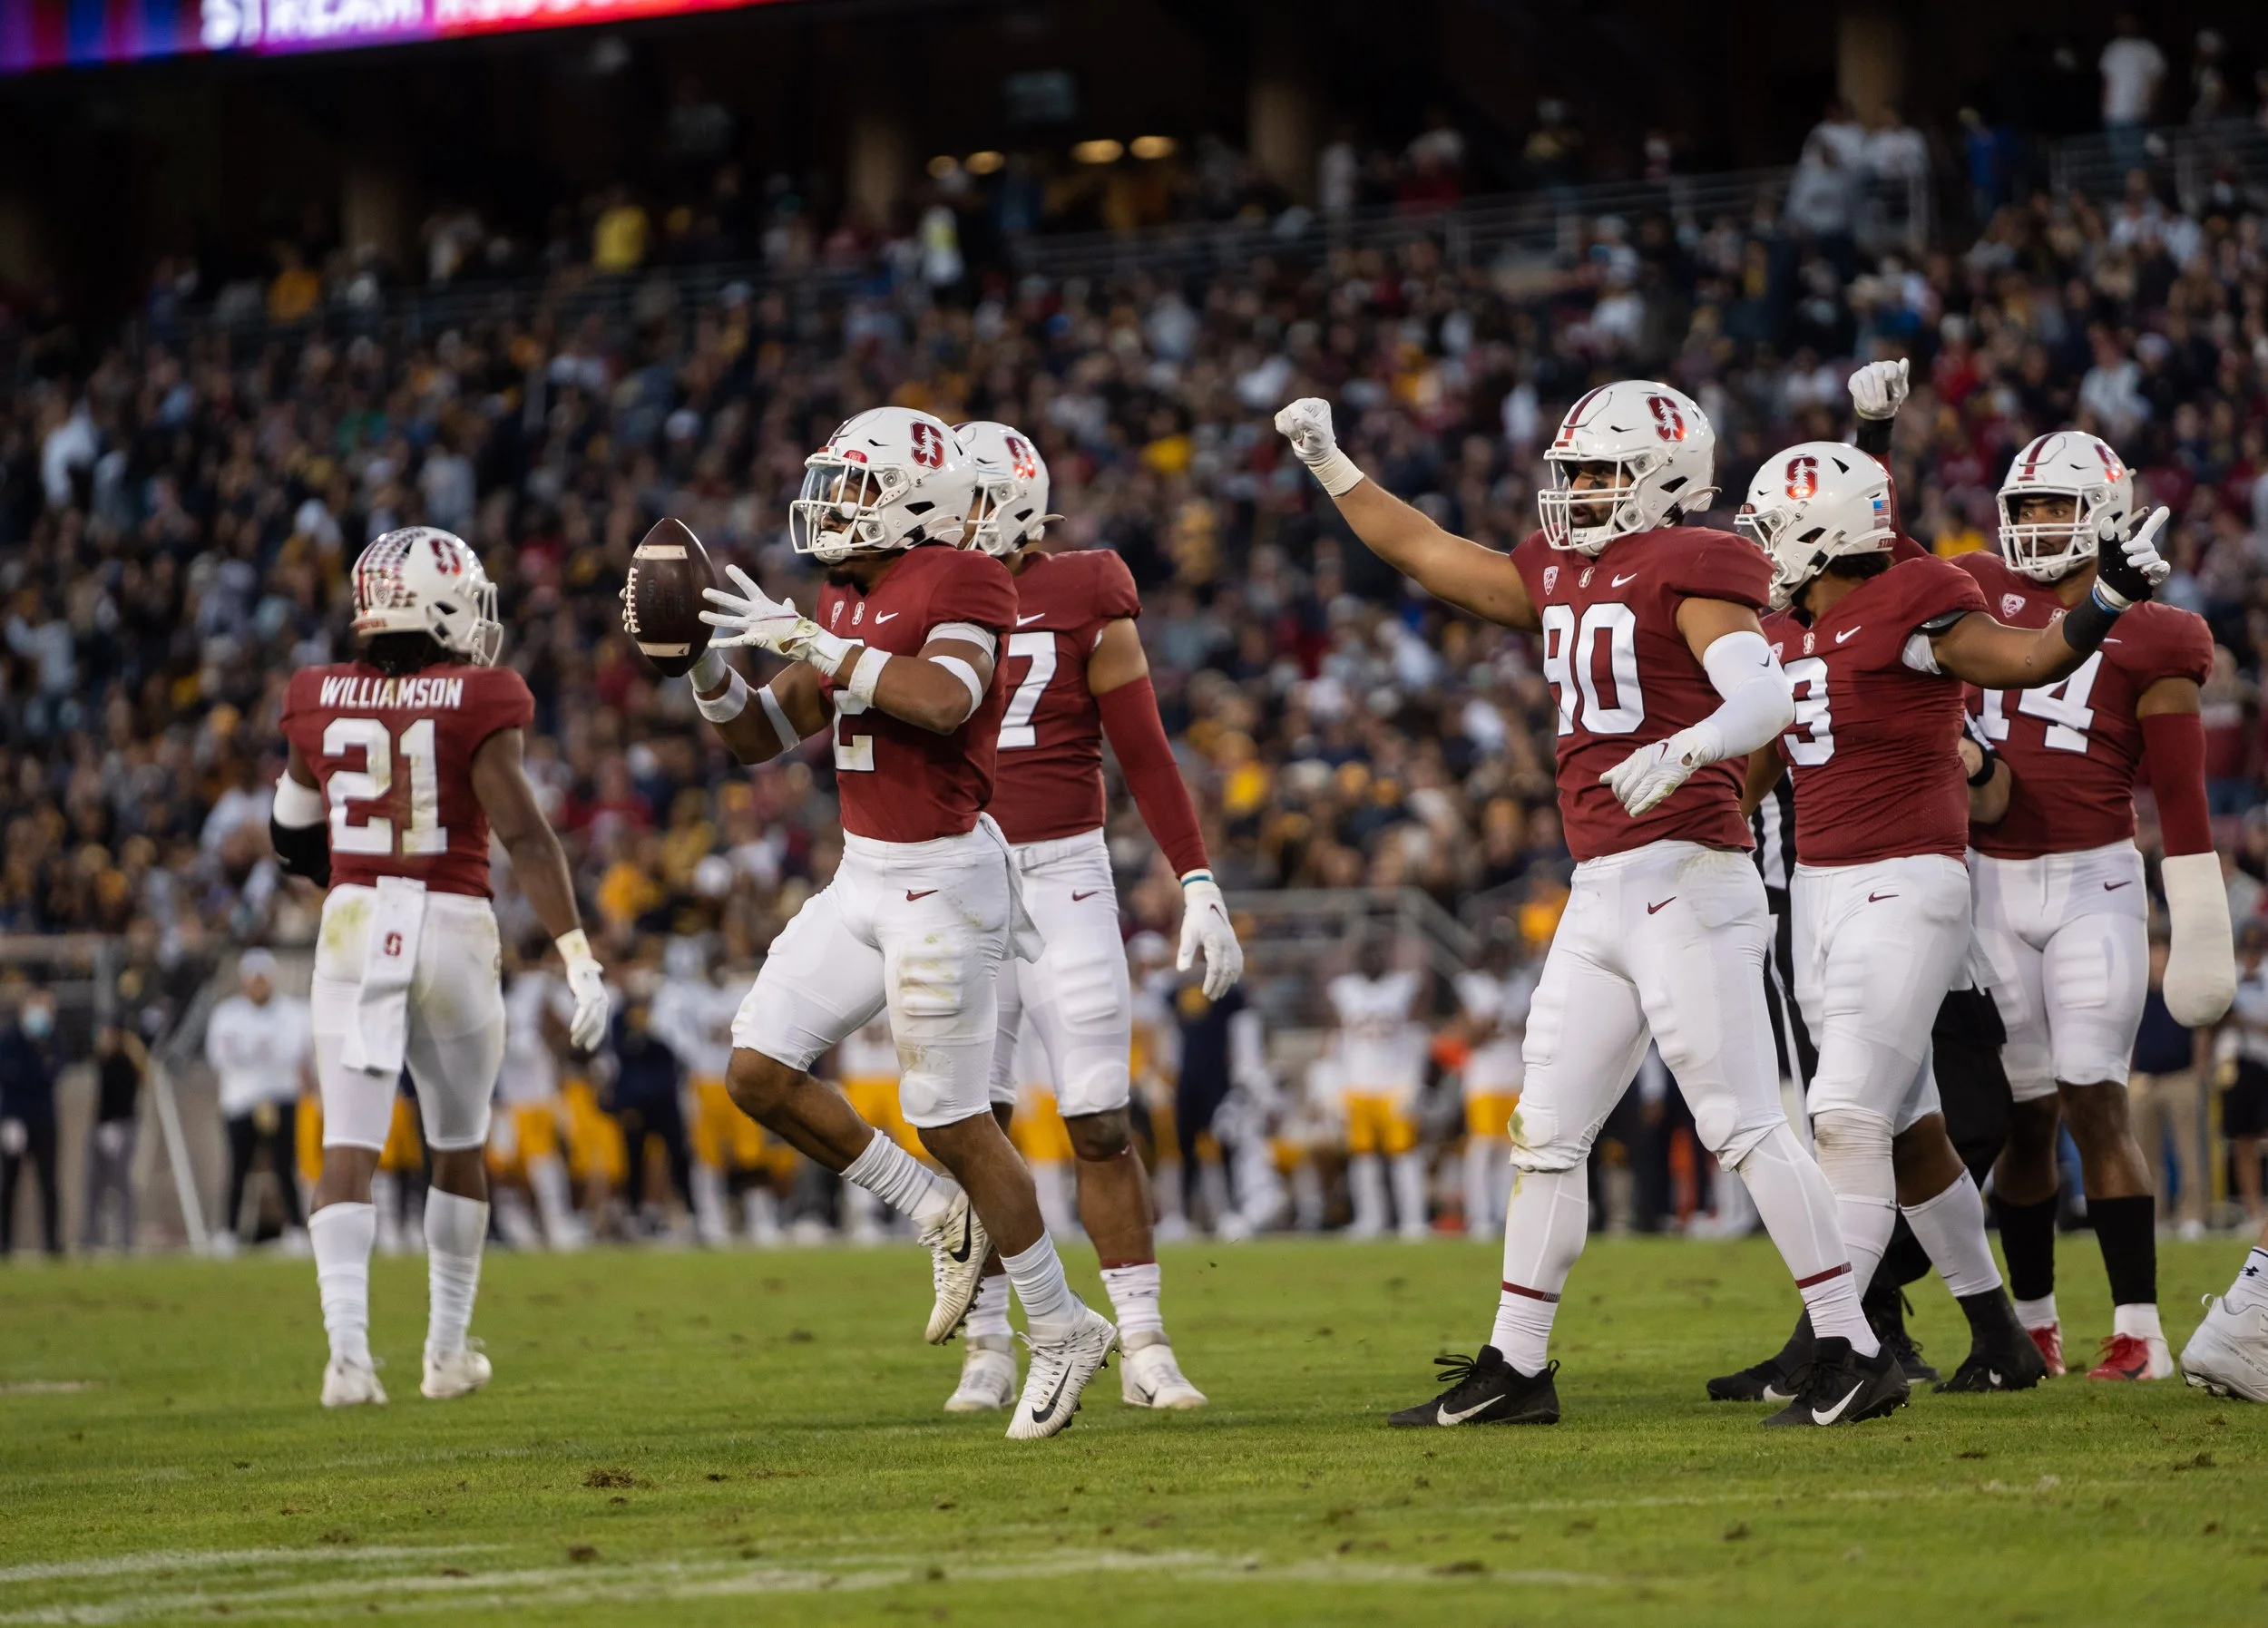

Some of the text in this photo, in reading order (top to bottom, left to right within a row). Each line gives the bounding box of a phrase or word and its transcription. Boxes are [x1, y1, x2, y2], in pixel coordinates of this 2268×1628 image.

[319, 675, 464, 709] WILLIAMSON
[997, 631, 1058, 749] 7
[1542, 602, 1645, 736] 90
[1783, 656, 1835, 765] 3
[323, 717, 448, 856] 21
